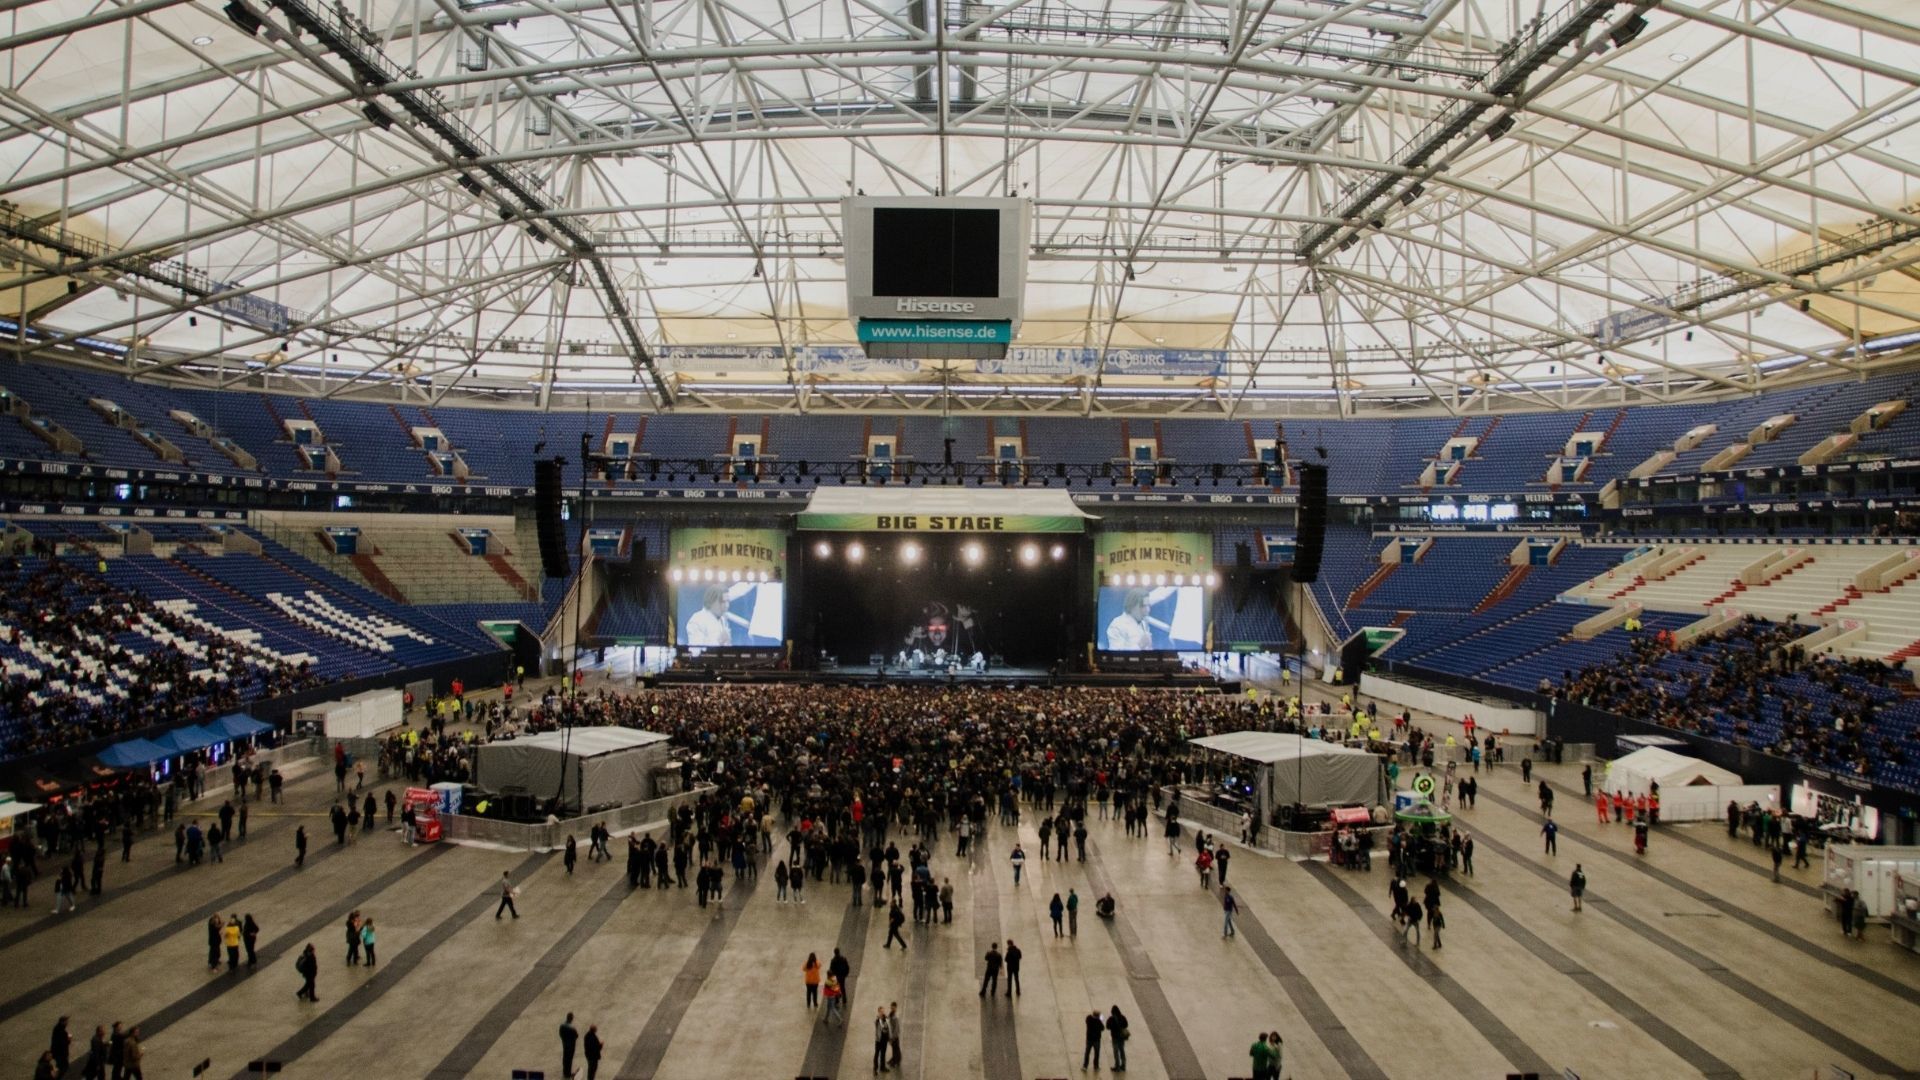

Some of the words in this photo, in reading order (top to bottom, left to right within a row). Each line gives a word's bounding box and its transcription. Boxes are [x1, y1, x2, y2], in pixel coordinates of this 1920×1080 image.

[896, 298, 975, 313] Hisense
[871, 325, 997, 338] www.hisense.de
[41, 463, 69, 475] VELTINS
[431, 486, 452, 494] ERGO
[485, 487, 511, 496] VELTINS
[684, 490, 705, 498] ERGO
[737, 491, 765, 499] VELTINS
[1210, 495, 1232, 503] ERGO
[1468, 494, 1489, 502] ERGO
[1525, 494, 1554, 502] VELTINS
[876, 516, 917, 529] BIG
[929, 516, 1004, 530] STAGE
[690, 543, 718, 560] ROCK
[721, 544, 733, 556] IM
[736, 544, 773, 562] REVIER
[1109, 548, 1137, 565] ROCK
[1140, 547, 1152, 560] IM
[1155, 547, 1192, 565] REVIER
